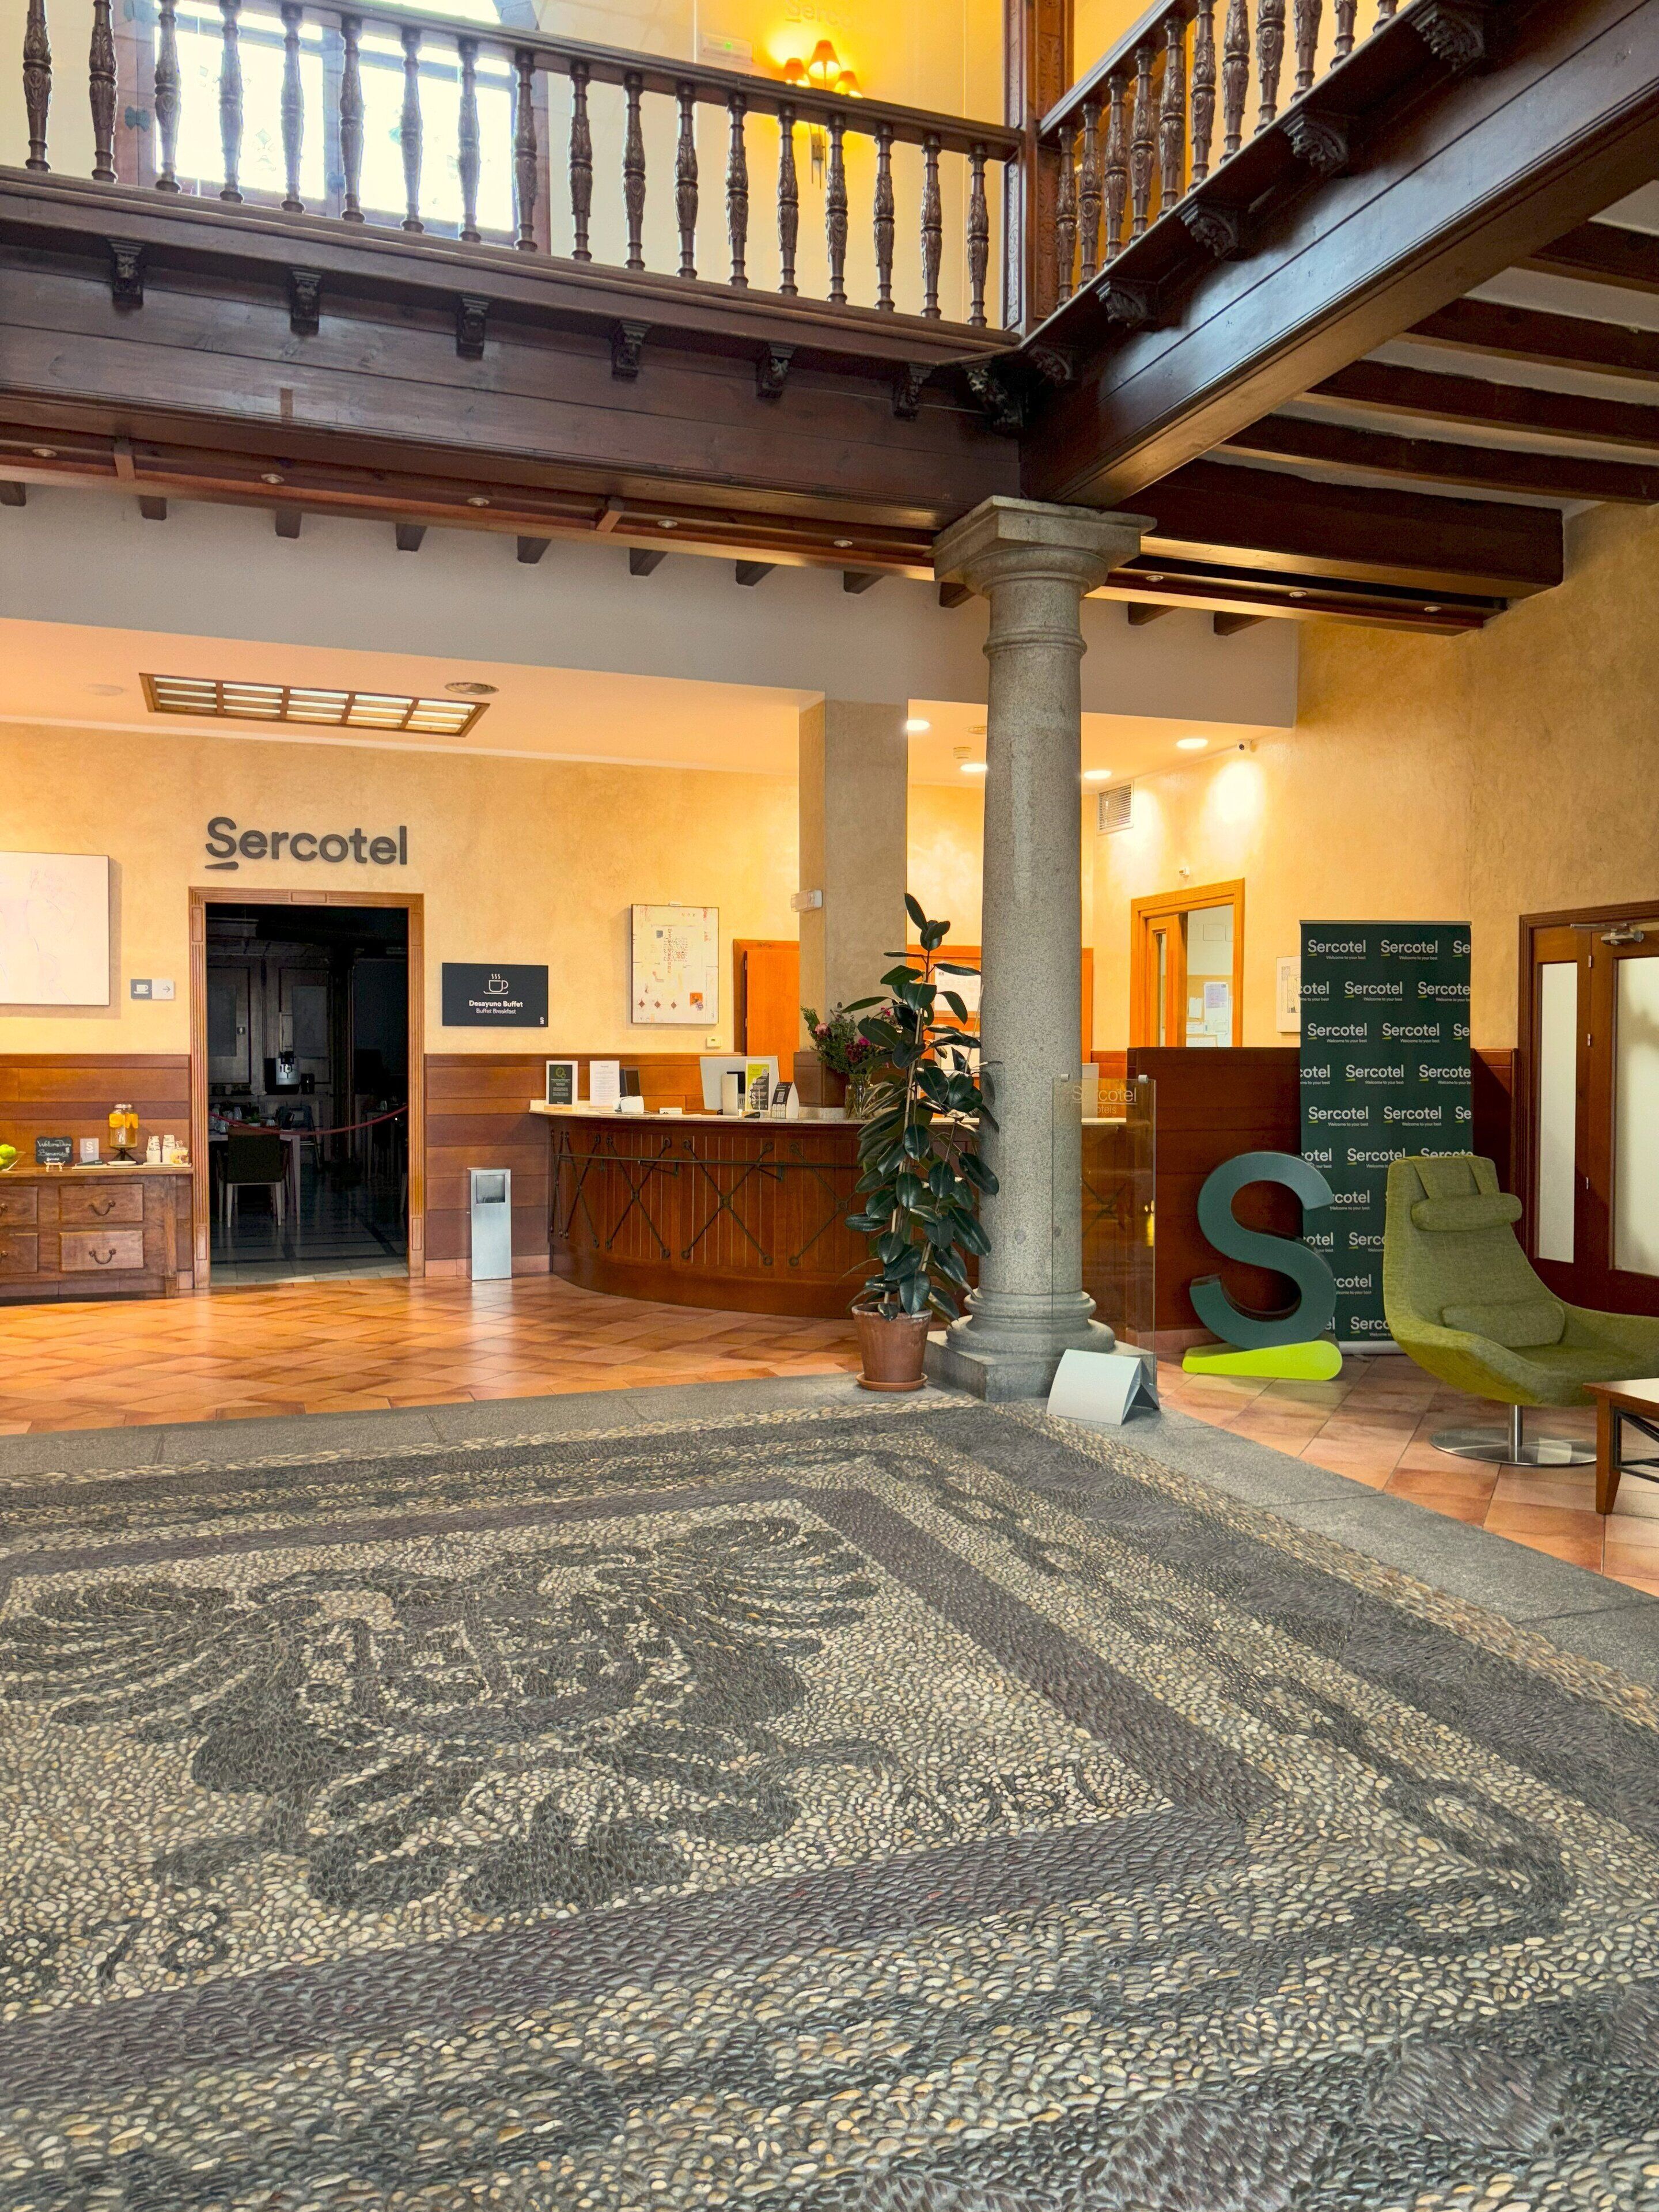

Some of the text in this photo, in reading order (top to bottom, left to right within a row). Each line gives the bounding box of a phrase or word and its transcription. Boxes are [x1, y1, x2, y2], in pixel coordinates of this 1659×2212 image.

[205, 816, 407, 865] Sercotel
[1308, 940, 1366, 953] Sercotel
[1381, 940, 1438, 953] Sercotel
[1344, 981, 1403, 995] Sercotel
[468, 1000, 502, 1008] Desayuno
[1308, 1022, 1368, 1036] Sercotel
[1382, 1022, 1440, 1036] Sercotel
[1346, 1065, 1404, 1078] Sercotel
[1073, 1085, 1137, 1102] Scotel
[1308, 1106, 1369, 1119] Sercotel
[1384, 1106, 1441, 1119] Sercotel
[1301, 1147, 1332, 1161] otel
[1347, 1147, 1406, 1161] Sercotel
[1304, 1232, 1334, 1245] otel
[1190, 1151, 1336, 1351] S
